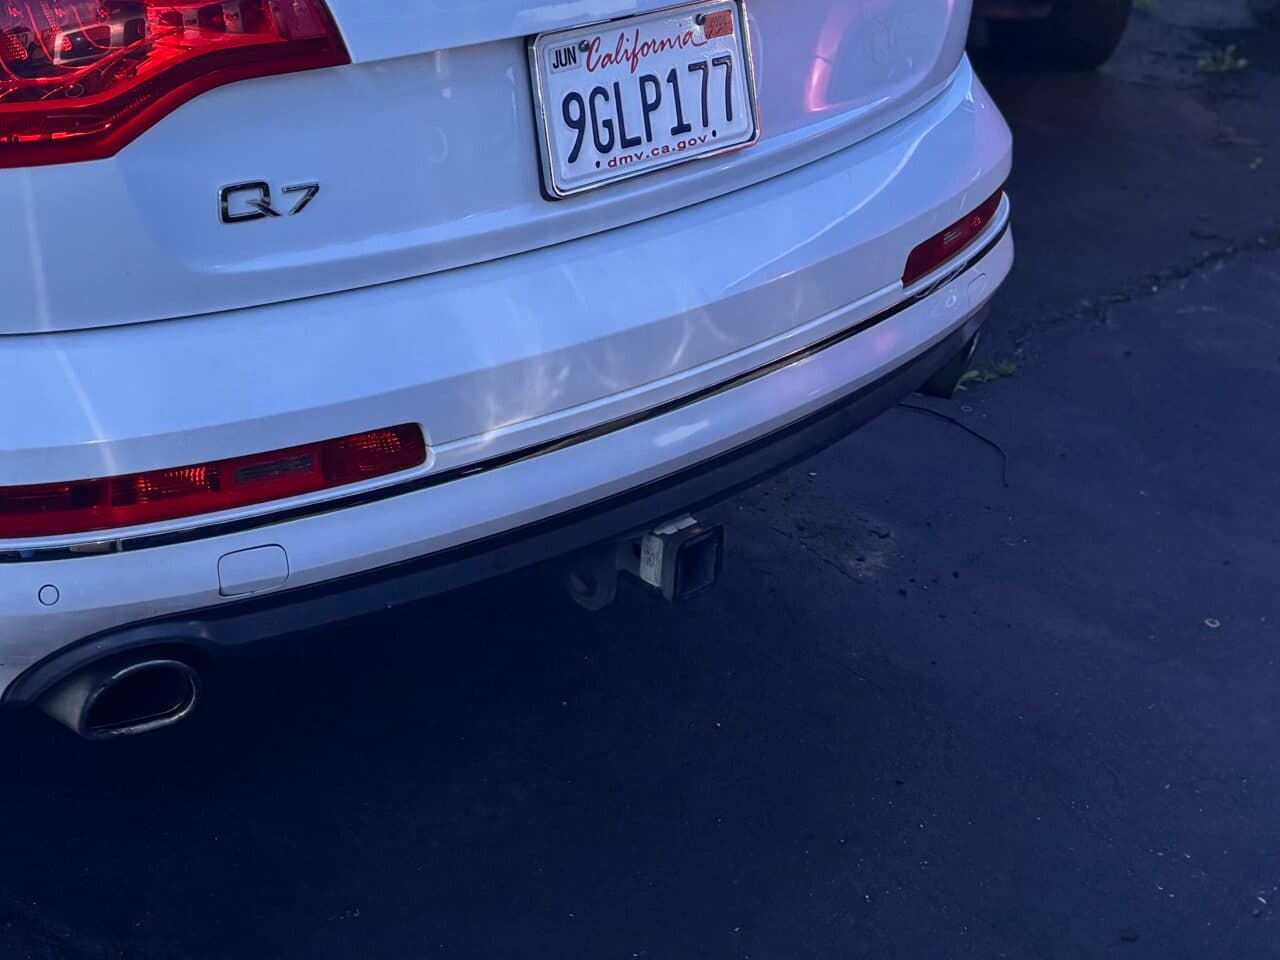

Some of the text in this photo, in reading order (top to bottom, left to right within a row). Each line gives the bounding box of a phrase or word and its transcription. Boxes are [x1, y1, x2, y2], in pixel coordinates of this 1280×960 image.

[552, 47, 578, 69] JUN
[586, 28, 708, 73] California
[562, 55, 733, 164] 9GLP177
[607, 133, 708, 168] dmv.ca.gov
[218, 180, 320, 224] Q7
